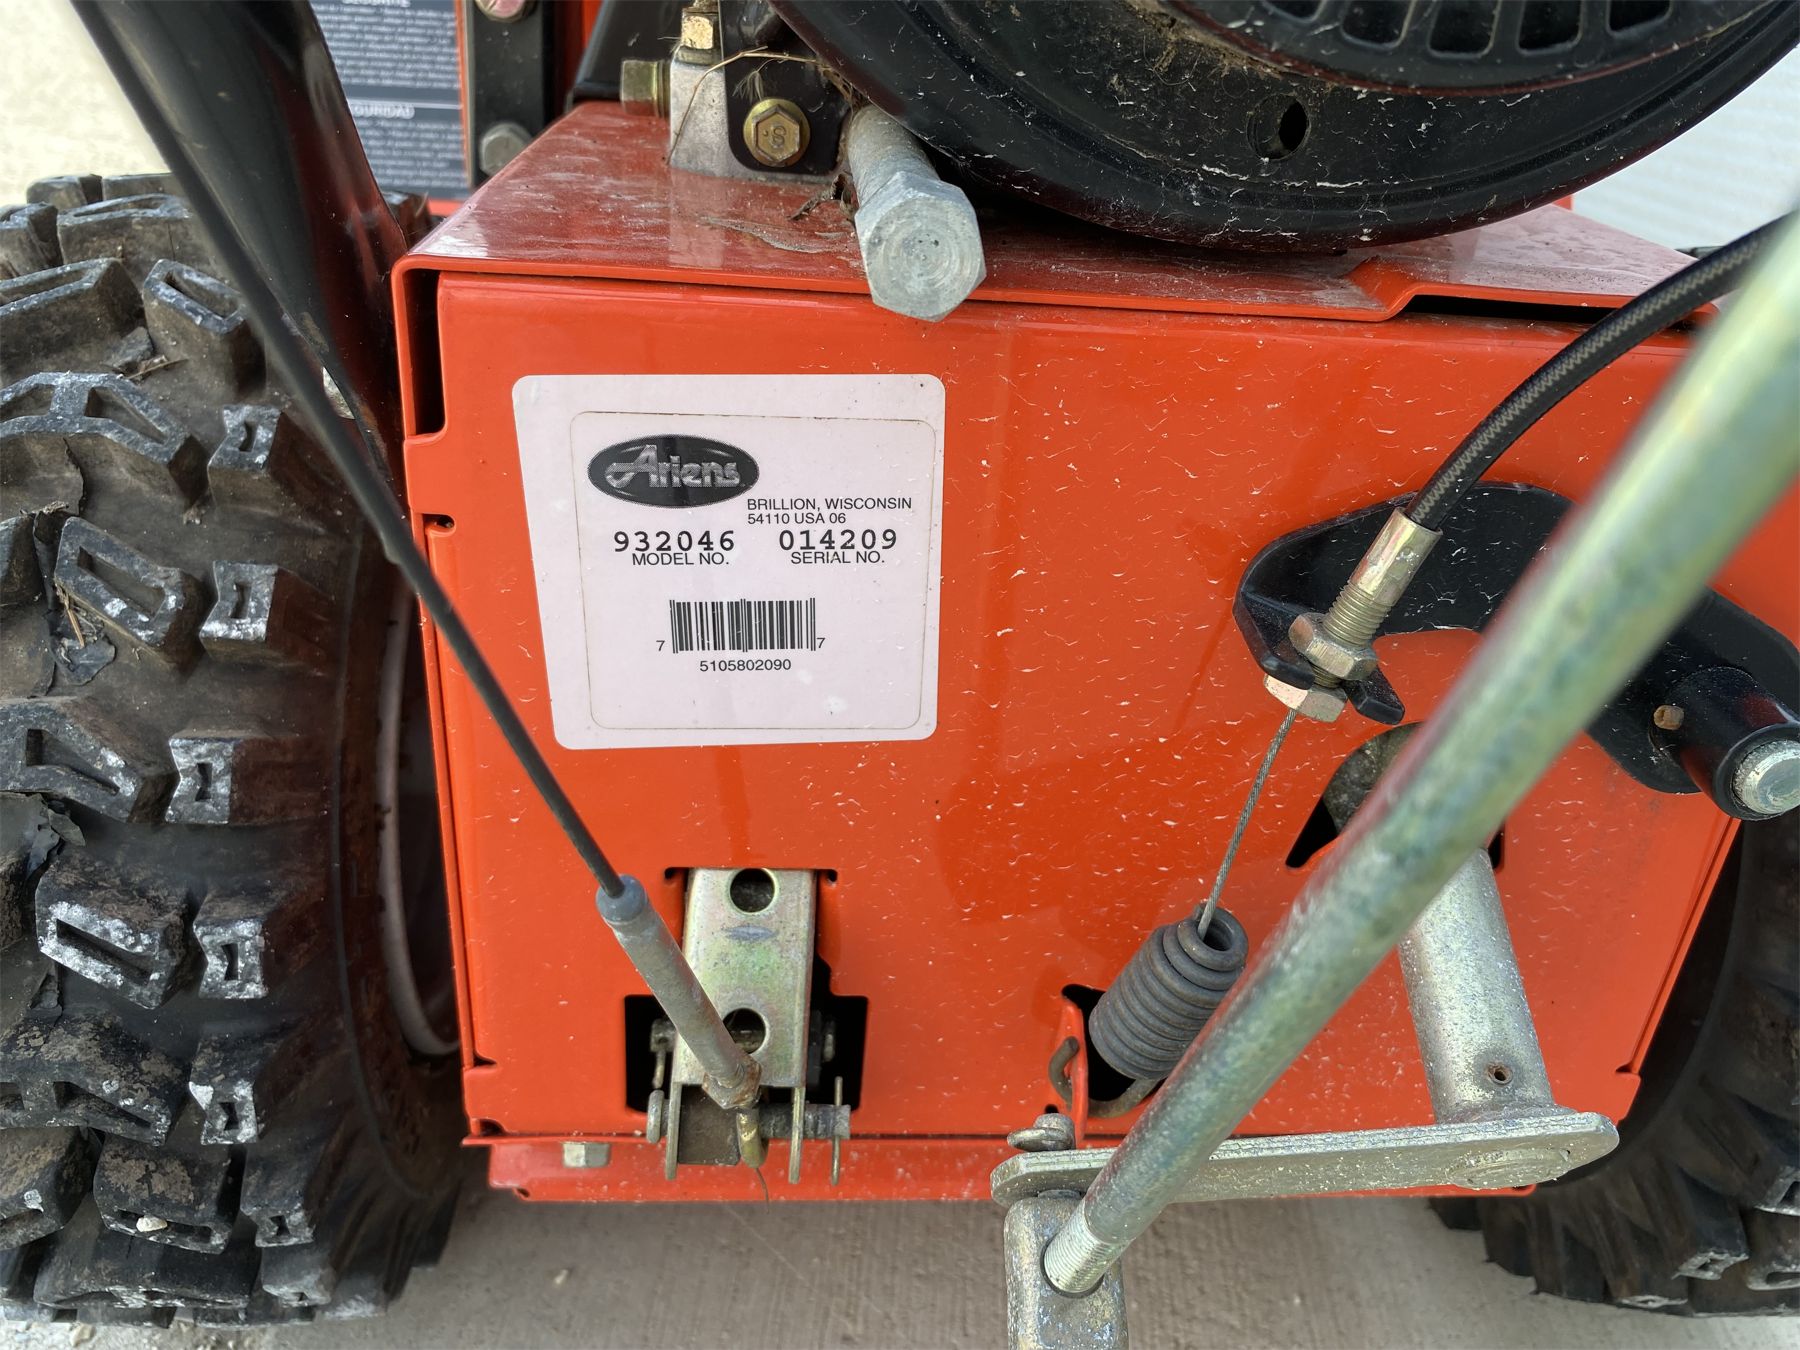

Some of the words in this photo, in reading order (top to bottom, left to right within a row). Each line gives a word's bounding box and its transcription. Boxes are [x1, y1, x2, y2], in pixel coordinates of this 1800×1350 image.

[605, 445, 741, 488] Ariens
[747, 498, 820, 512] BRILLION,
[825, 498, 912, 510] WISCONSIN
[747, 512, 791, 525] 54110
[794, 511, 826, 525] USA
[829, 512, 847, 524] 06
[614, 530, 735, 553] 932046
[778, 528, 897, 550] 014209
[632, 552, 694, 566] MODEL
[699, 552, 730, 566] NO.
[790, 551, 851, 565] SERIAL
[856, 551, 885, 564] NO.
[656, 640, 666, 652] 7
[816, 638, 826, 649] 7
[699, 659, 792, 672] 5105802090
